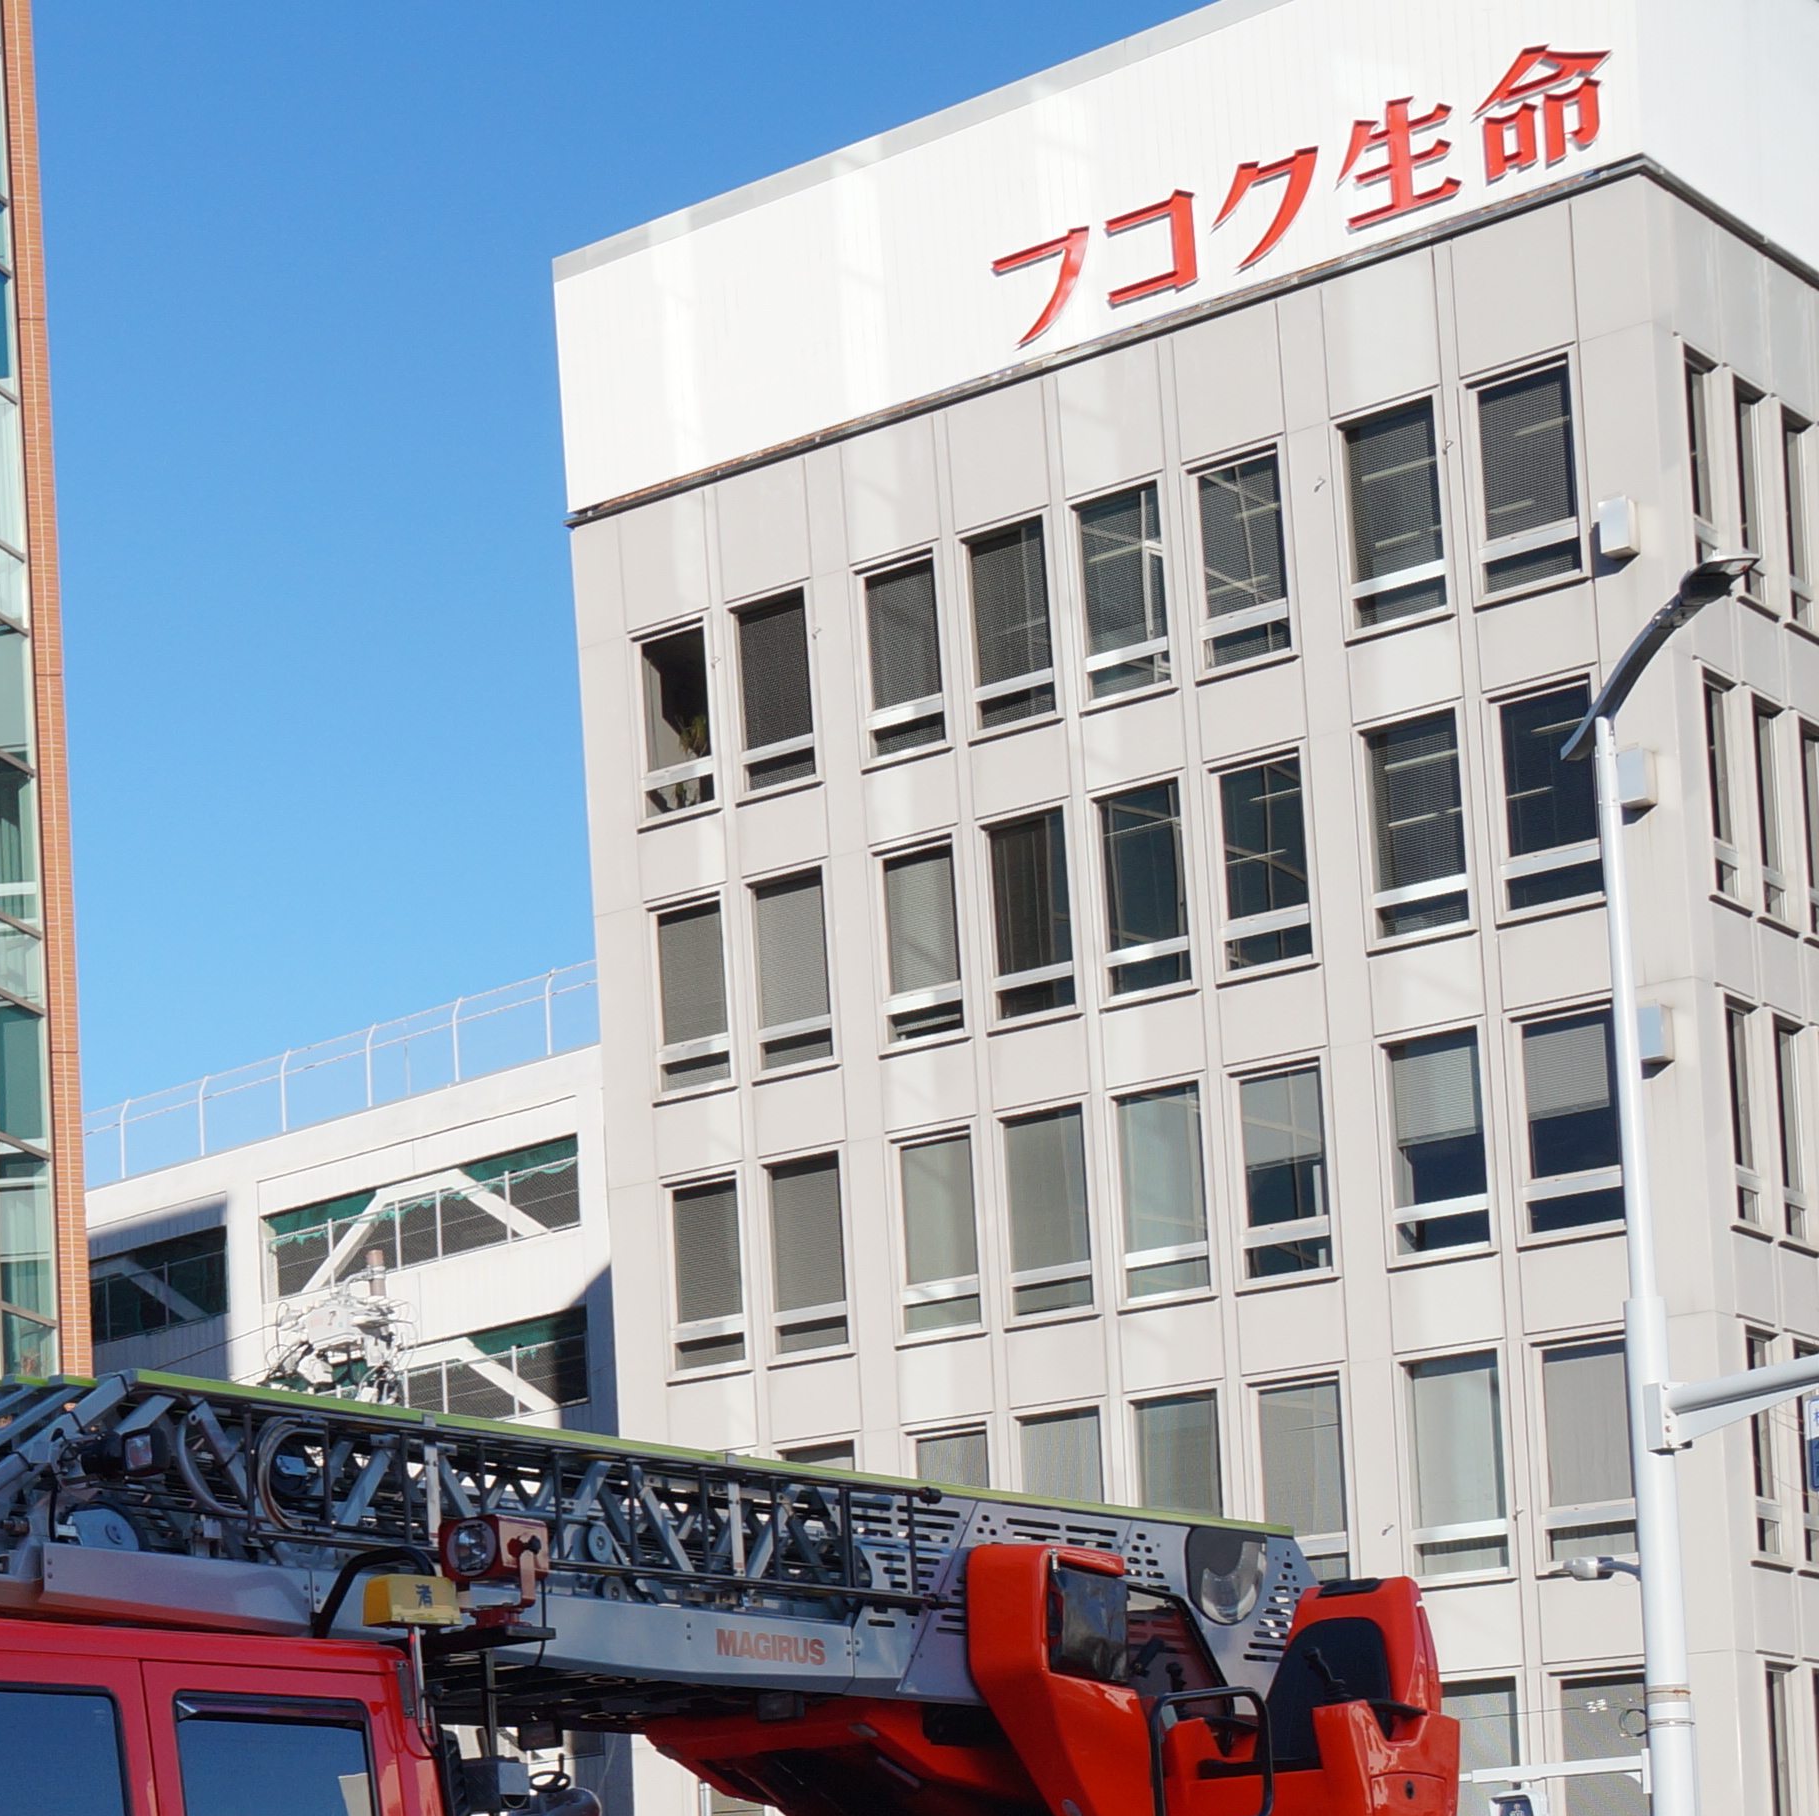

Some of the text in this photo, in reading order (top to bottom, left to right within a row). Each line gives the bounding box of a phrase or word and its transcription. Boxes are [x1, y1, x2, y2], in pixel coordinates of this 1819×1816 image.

[990, 43, 1612, 349] フコク生命
[716, 1628, 826, 1666] MAGIRUS
